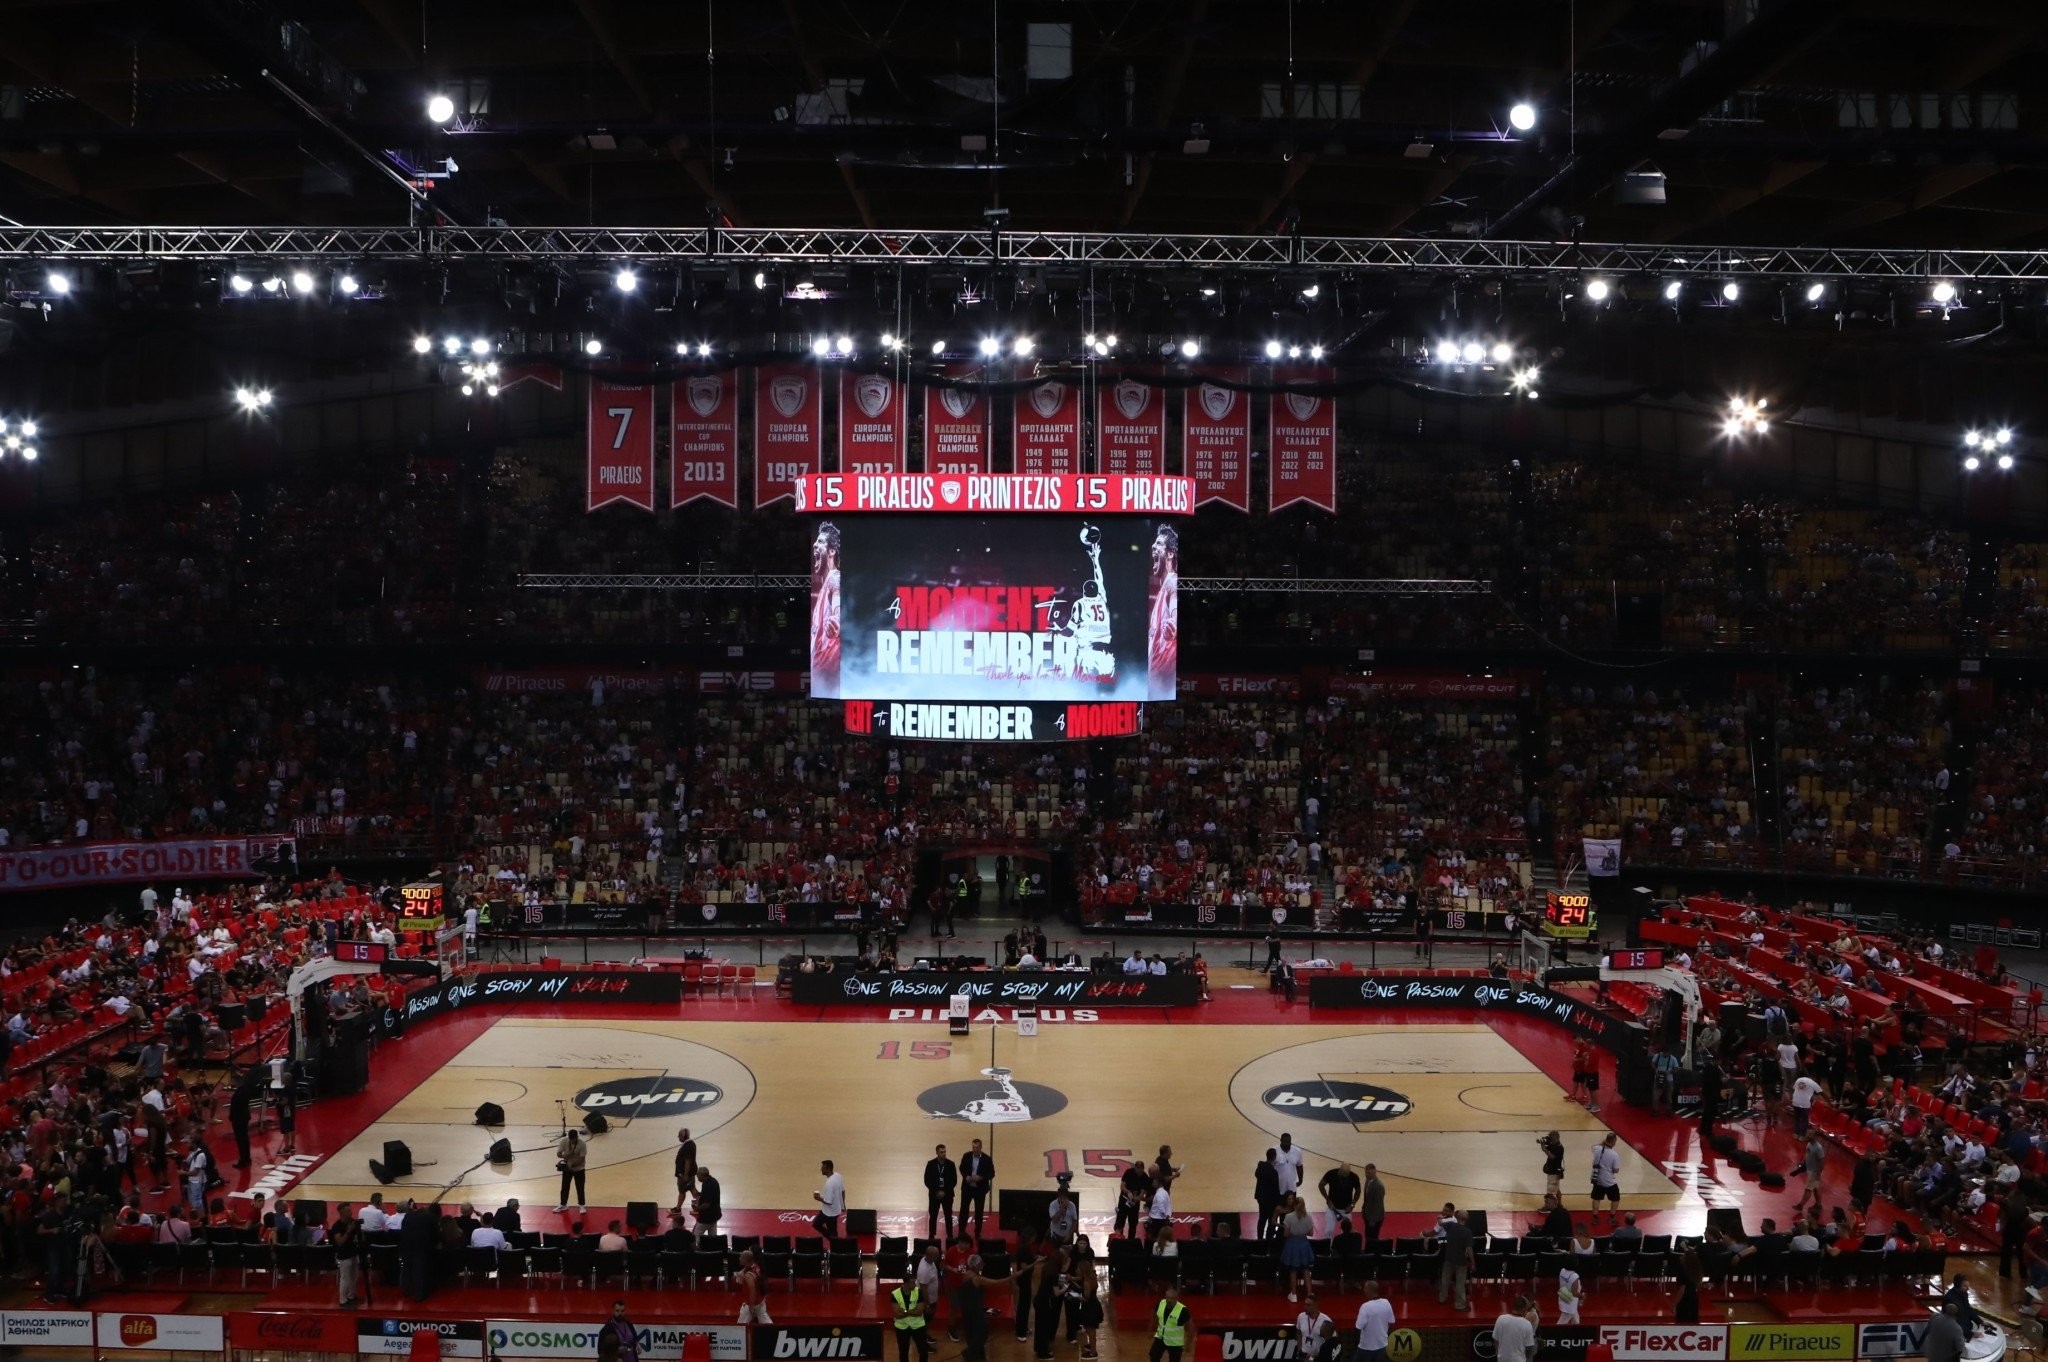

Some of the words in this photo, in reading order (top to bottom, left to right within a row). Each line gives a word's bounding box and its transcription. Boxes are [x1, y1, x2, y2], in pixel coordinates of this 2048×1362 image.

[608, 407, 634, 450] 7
[698, 433, 711, 441] CUP
[769, 423, 807, 433] EUROPEAN
[853, 423, 892, 433] EUROPEAN
[683, 443, 725, 452] CHAMPIONS
[767, 433, 809, 443] CHAMPIONS
[852, 433, 894, 443] CHAMPIONS
[939, 434, 977, 443] EUROPEAN
[937, 444, 979, 454] CHAMPIONS
[600, 465, 642, 485] PIRAEUS
[683, 461, 725, 482] 2013
[766, 462, 810, 482] 1997
[814, 477, 843, 508] 15
[858, 476, 935, 510] PIRAEUS
[967, 476, 1062, 511] PRINTEZIS
[1075, 477, 1108, 509] 15
[1121, 477, 1188, 512] PIRAEUS
[896, 586, 1056, 632] MOMENT
[1091, 604, 1105, 622] 15
[877, 630, 1078, 675] REMEMBER
[506, 673, 566, 692] Piraeus
[699, 671, 775, 691] FMS
[1017, 672, 1033, 688] you
[1445, 683, 1484, 693] NEVER
[1487, 683, 1515, 694] QUIT
[890, 702, 1033, 740] REMEMBER
[1066, 702, 1138, 738] MOMENT
[0, 856, 37, 883] TO
[50, 851, 113, 879] OUR
[121, 846, 242, 875] SOLDIER
[401, 888, 431, 900] 90:00
[1558, 895, 1589, 907] 90:00
[404, 900, 428, 916] 24
[524, 905, 544, 924] 15
[1198, 905, 1216, 923] 15
[1560, 908, 1585, 924] 24
[1446, 911, 1466, 930] 15
[353, 945, 369, 960] 15
[1629, 951, 1645, 967] 15
[408, 991, 441, 1020] PASSION
[485, 977, 533, 998] STORY
[538, 976, 569, 997] MY
[843, 976, 881, 1001] ONE
[888, 979, 948, 1002] PASSION
[958, 981, 994, 1002] ONE
[1001, 980, 1049, 1002] STORY
[1054, 979, 1085, 1001] MY
[1361, 978, 1399, 1000] ONE
[1406, 981, 1465, 999] PASSION
[1474, 985, 1511, 1007] ONE
[1516, 990, 1553, 1010] STORY
[1555, 1003, 1575, 1022] MY
[876, 1040, 952, 1060] 15
[580, 1087, 718, 1109] bwin
[998, 1102, 1021, 1112] 15
[1268, 1090, 1409, 1112] bwin
[1044, 1148, 1133, 1178] 15
[229, 1151, 324, 1200] bwin
[8, 1318, 45, 1327] ΟΜΙΛΟΣ
[47, 1318, 90, 1328] ΙΑΤΡΙΚΟΥ
[8, 1327, 50, 1335] ΑΘΗΝΩΝ
[124, 1320, 154, 1335] alfa
[398, 1321, 457, 1335] ΟΜΗΡΟΣ
[383, 1340, 413, 1350] Aegea
[511, 1331, 599, 1348] COSMOT
[773, 1327, 864, 1358] bwin
[1393, 1335, 1413, 1352] M
[1560, 1339, 1593, 1348] QUIT
[1625, 1330, 1723, 1352] FlexCar
[1769, 1333, 1841, 1351] Piraeus
[1862, 1324, 1930, 1353] FM
